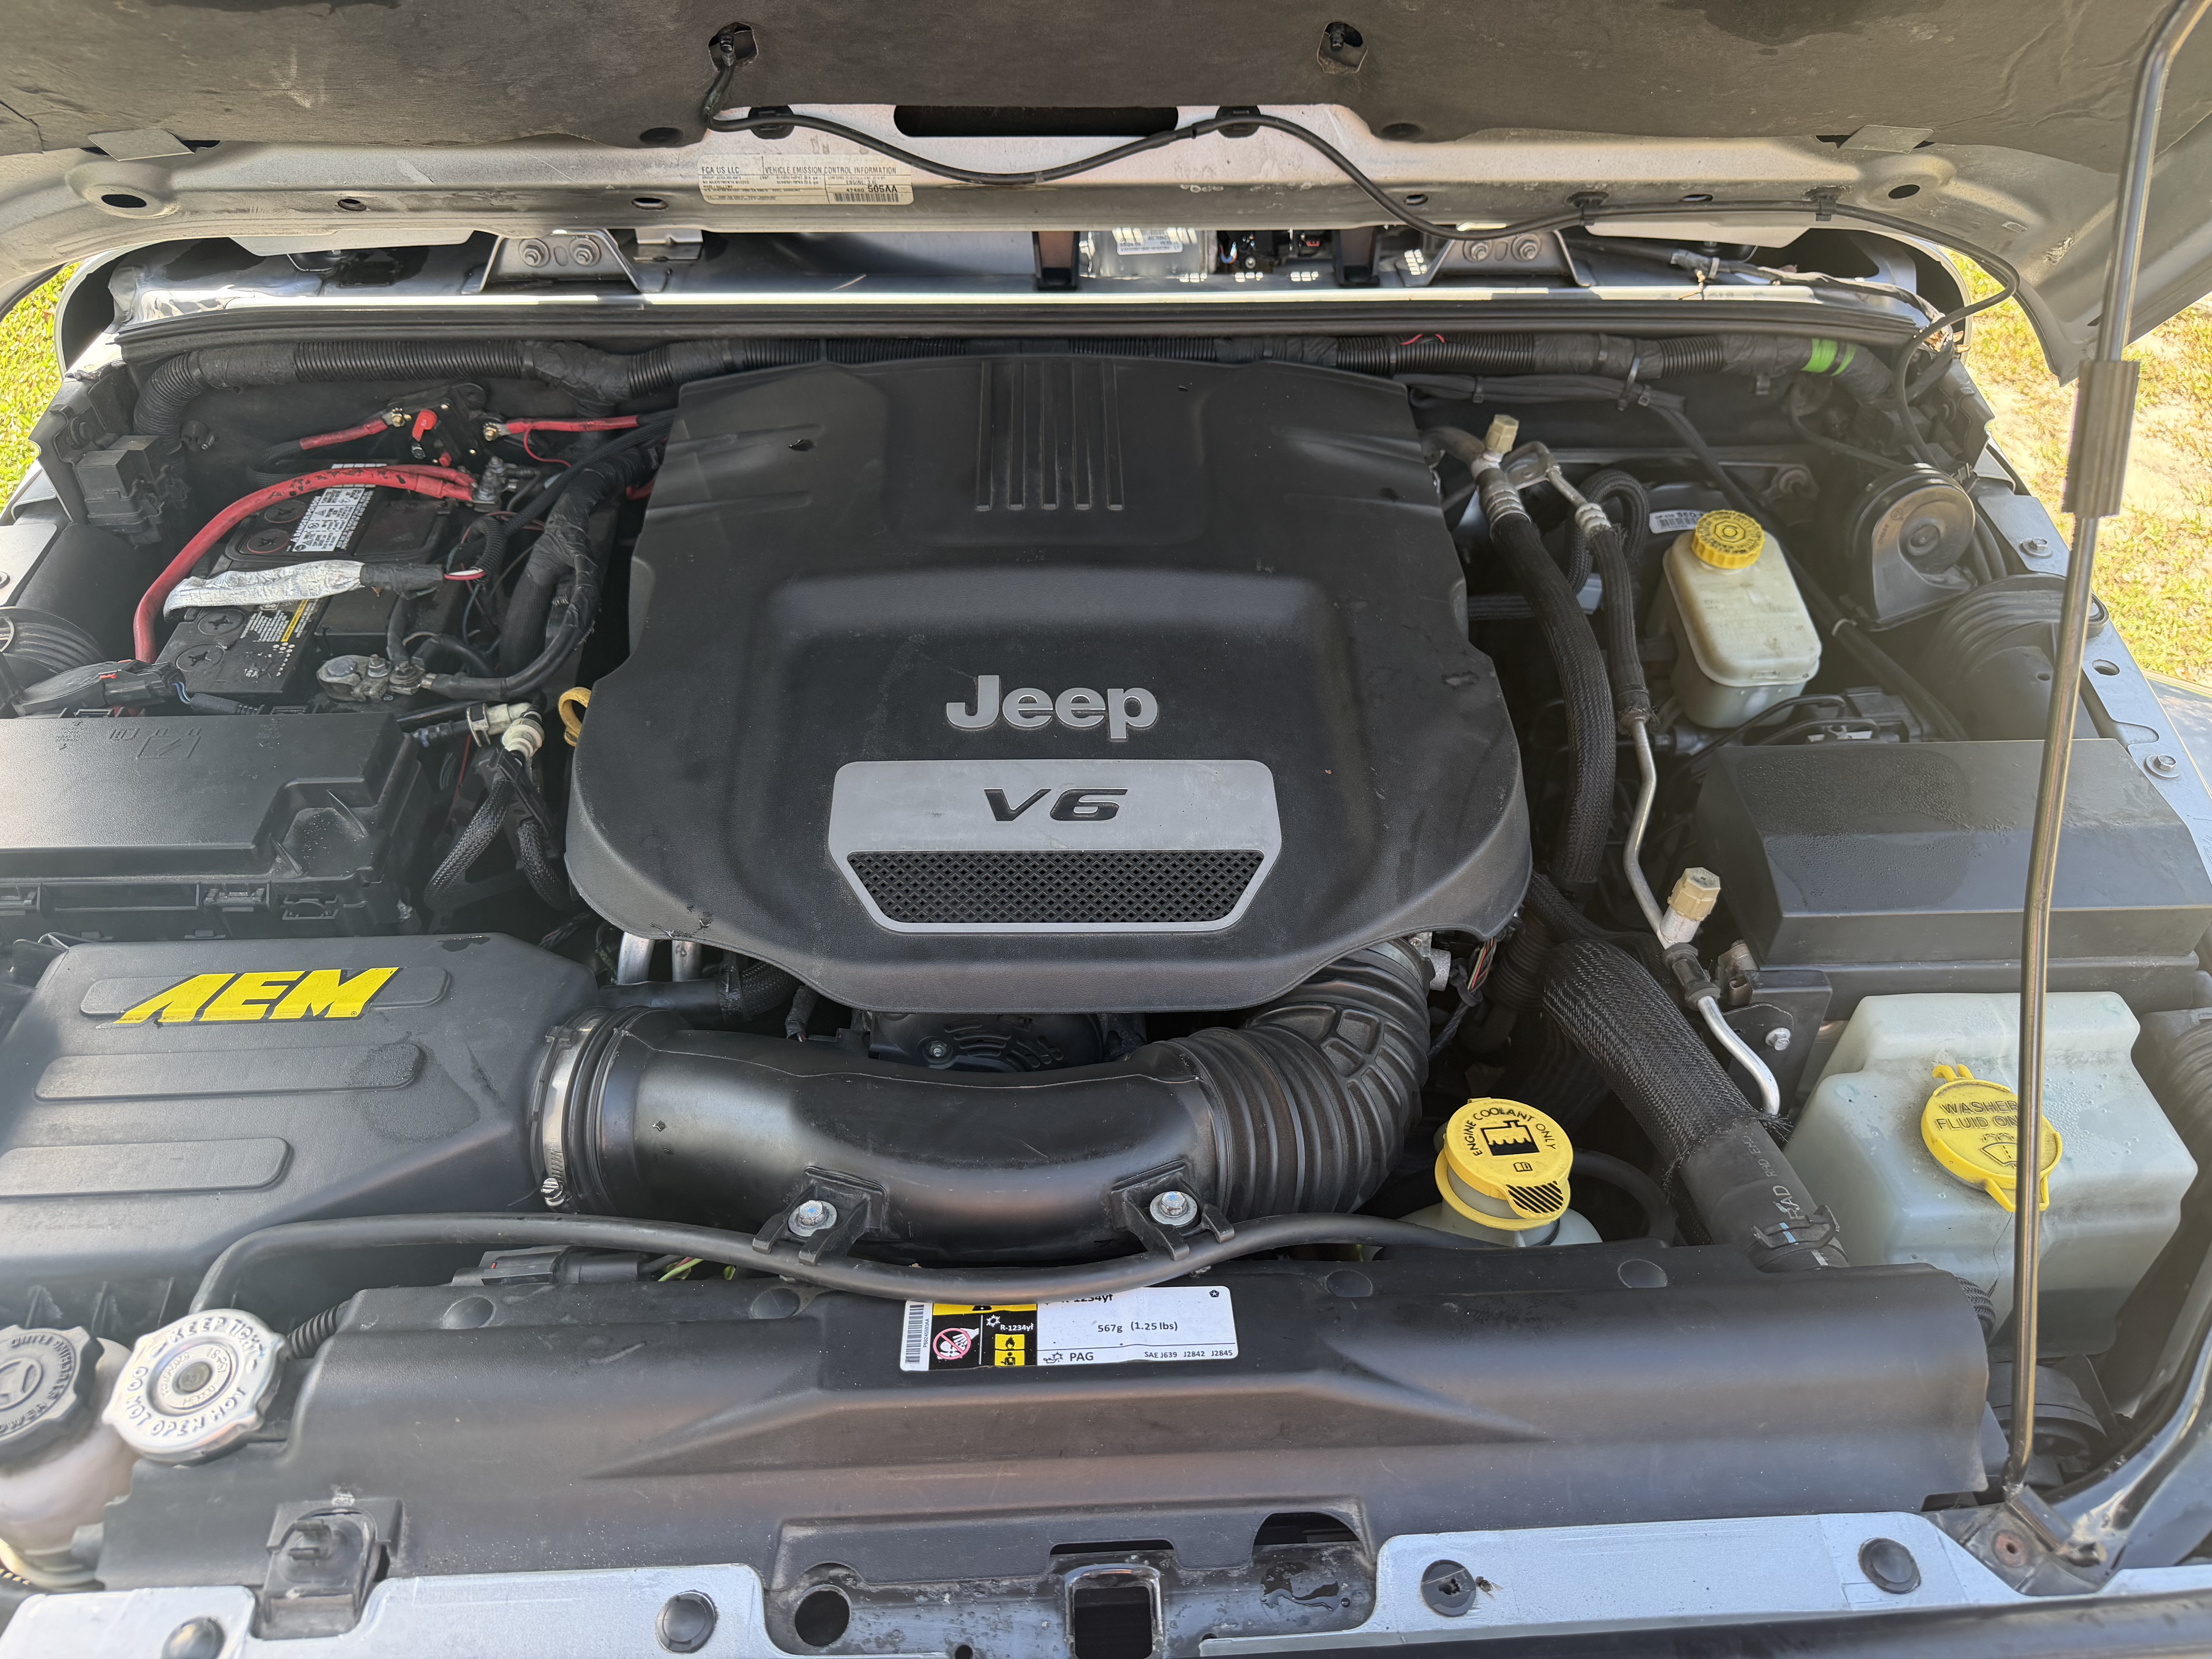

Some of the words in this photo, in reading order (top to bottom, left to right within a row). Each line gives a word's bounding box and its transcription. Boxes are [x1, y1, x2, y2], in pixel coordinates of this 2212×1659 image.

[868, 184, 898, 193] 505AA
[946, 675, 1159, 741] Jeep
[984, 788, 1128, 822] V6
[112, 967, 400, 1024] AEM
[1940, 1100, 2018, 1115] WASHER
[1463, 1120, 1483, 1156] ENGINE
[1473, 1107, 1535, 1122] COOLANT
[1535, 1123, 1557, 1150] ONLY
[1936, 1117, 1989, 1131] FLUID
[1993, 1115, 2018, 1128] ON
[1772, 1185, 1805, 1219] RAD
[168, 1316, 227, 1343] KEEP
[228, 1318, 264, 1353] TIGHT
[1000, 1322, 1034, 1332] R-1234yf
[1097, 1324, 1123, 1333] 567g
[1130, 1321, 1158, 1331] (1.25
[1159, 1321, 1178, 1331] lbs)
[1070, 1352, 1094, 1362] PAG
[127, 1366, 149, 1391] DO
[125, 1395, 152, 1426] NOT
[209, 1386, 247, 1421] HOT
[151, 1416, 205, 1437] OPEN
